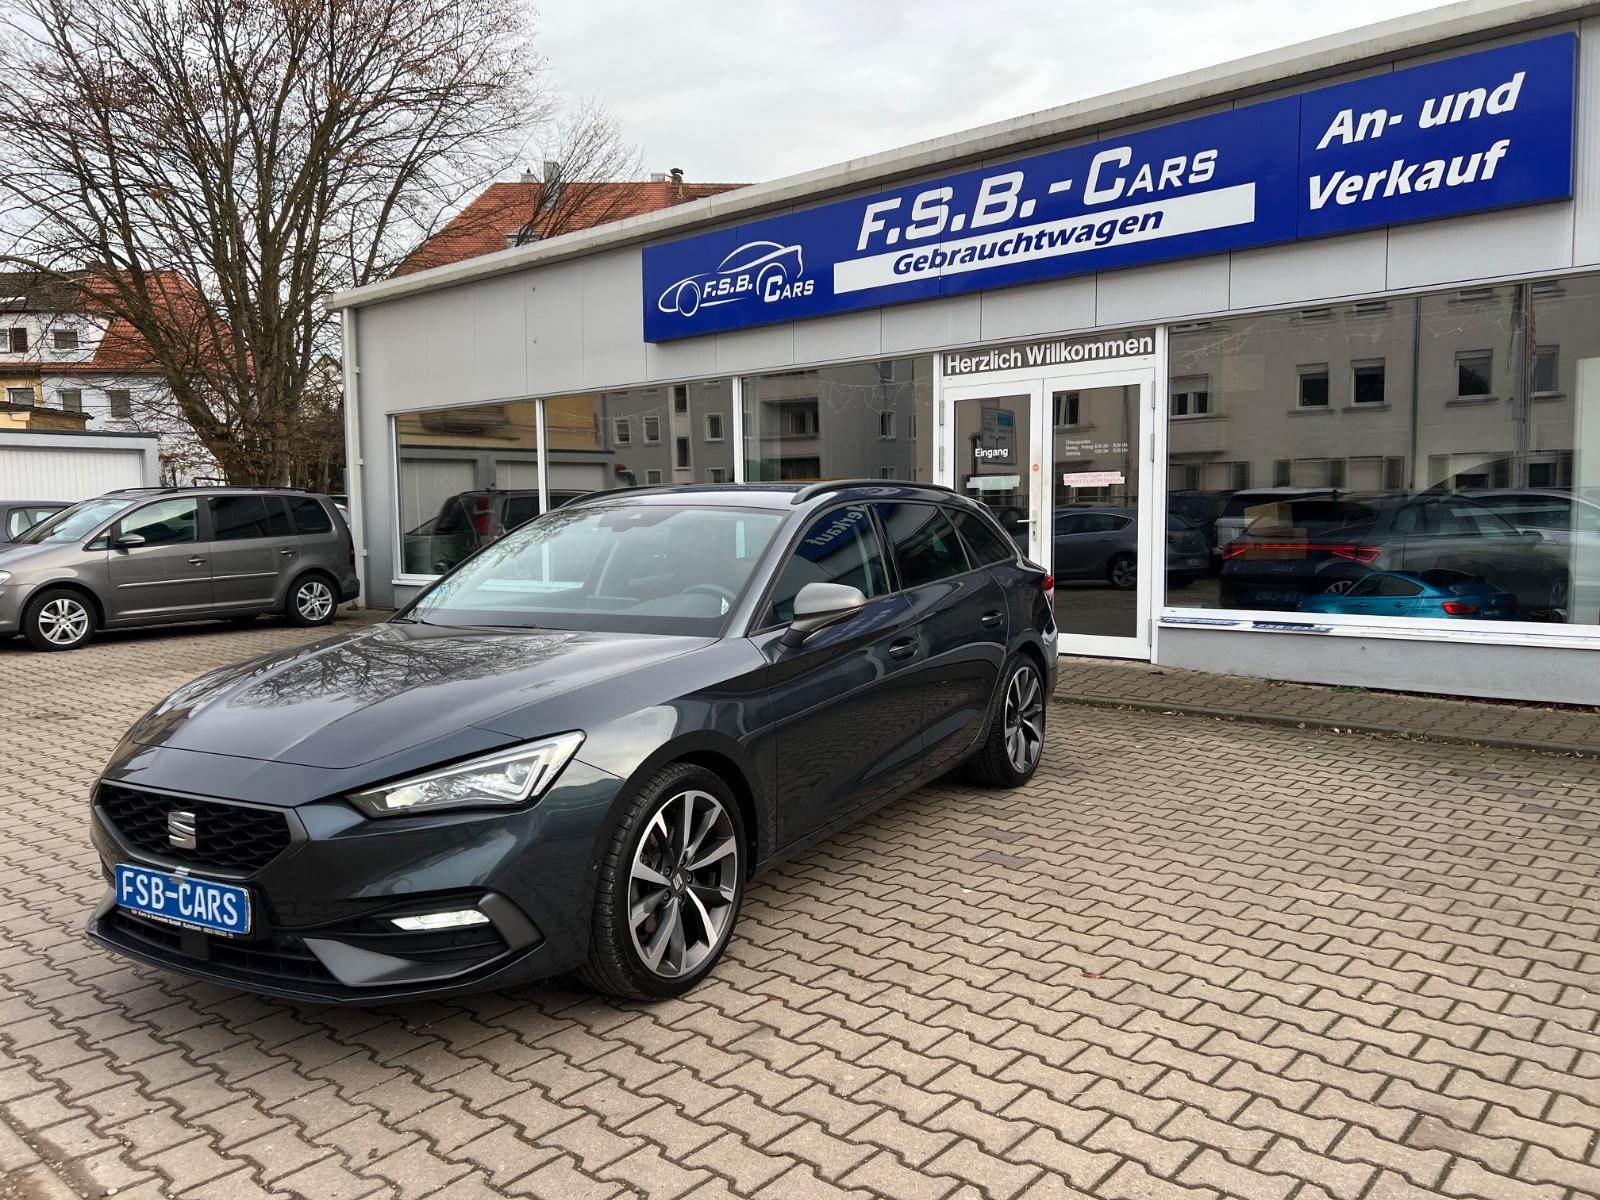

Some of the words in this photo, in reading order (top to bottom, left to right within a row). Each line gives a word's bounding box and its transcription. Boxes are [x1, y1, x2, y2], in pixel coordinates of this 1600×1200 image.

[1316, 108, 1403, 150] An-
[1418, 71, 1526, 129] und
[1309, 139, 1511, 210] Verkauf
[892, 210, 1164, 276] Gebrauchtwagen
[702, 274, 754, 299] F.S.B.
[946, 348, 1022, 375] Herzlich
[1025, 336, 1154, 367] Willkommen
[974, 447, 1009, 459] Eingang
[122, 870, 238, 926] FSB-CARS
